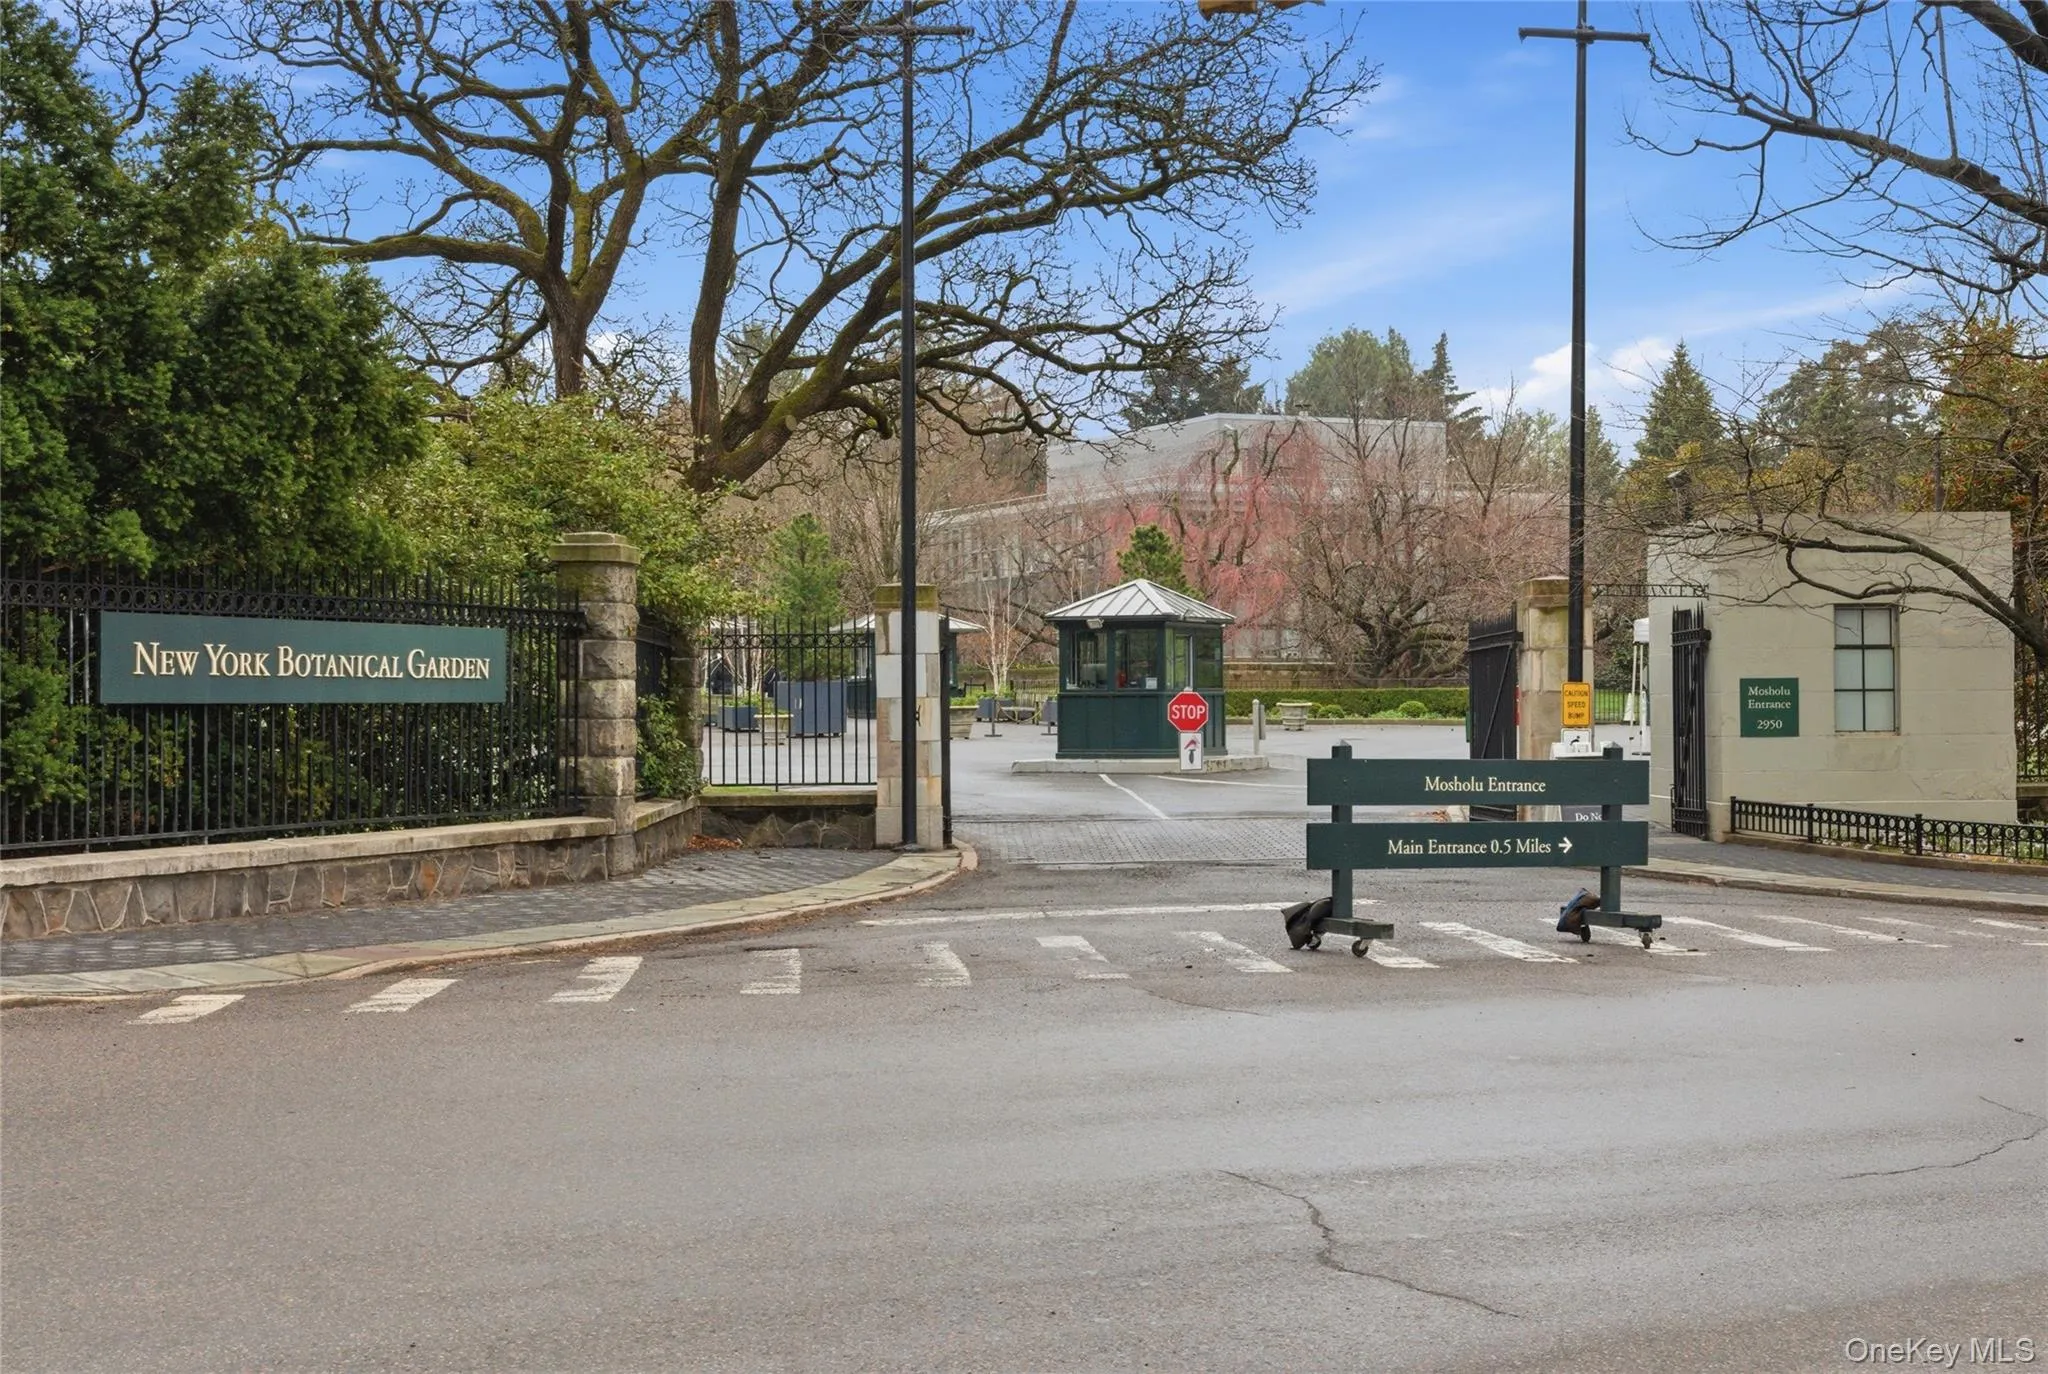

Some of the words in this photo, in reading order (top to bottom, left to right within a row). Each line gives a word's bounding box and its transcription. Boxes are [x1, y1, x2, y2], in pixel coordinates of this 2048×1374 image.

[133, 641, 200, 676] NEW
[204, 643, 271, 678] YORK
[277, 645, 403, 679] BOTANICAL
[406, 648, 491, 681] GARDEN
[1748, 685, 1791, 696] Mosholu
[1567, 701, 1586, 709] SPEED
[1748, 699, 1792, 709] Entrance
[1171, 704, 1206, 720] STOP
[1757, 719, 1783, 730] 2950
[1424, 776, 1484, 793] Mosholu
[1488, 777, 1547, 793] Entrance
[1575, 812, 1589, 822] Do
[1388, 840, 1424, 855] Main
[1428, 840, 1488, 855] Entrance
[1491, 839, 1511, 855] 0.5
[1516, 838, 1552, 854] Miles
